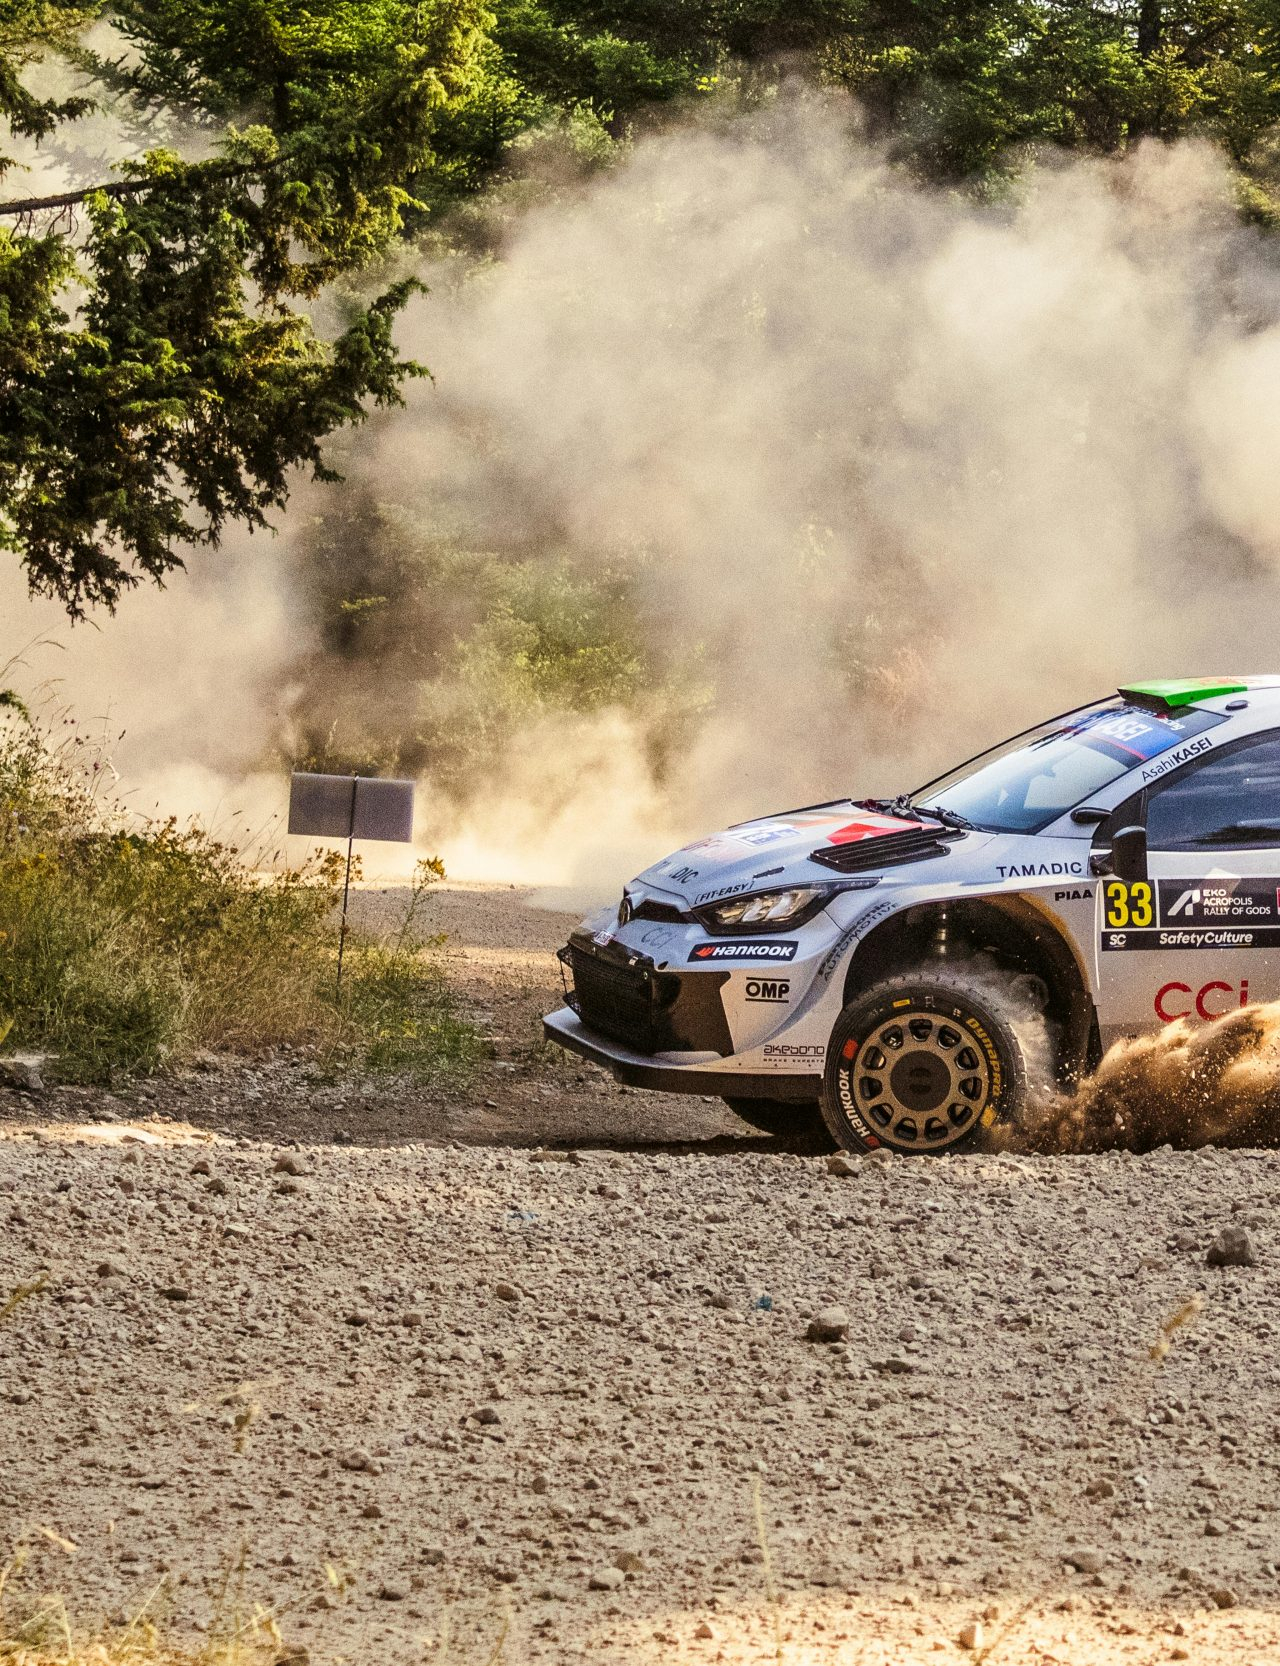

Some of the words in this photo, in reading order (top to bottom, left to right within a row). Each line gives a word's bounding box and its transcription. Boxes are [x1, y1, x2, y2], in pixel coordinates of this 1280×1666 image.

[996, 861, 1083, 878] TAMADIC
[1054, 889, 1094, 901] PIAA
[1203, 889, 1227, 897] EKO
[1107, 881, 1153, 928] 33
[1203, 897, 1253, 906] ACROPOLIS
[1203, 907, 1230, 916] RALLY
[1231, 907, 1244, 915] OF
[1245, 906, 1271, 915] GODS
[1109, 933, 1127, 946] SC
[1159, 931, 1254, 948] SafetyCulture
[745, 981, 790, 999] OMP
